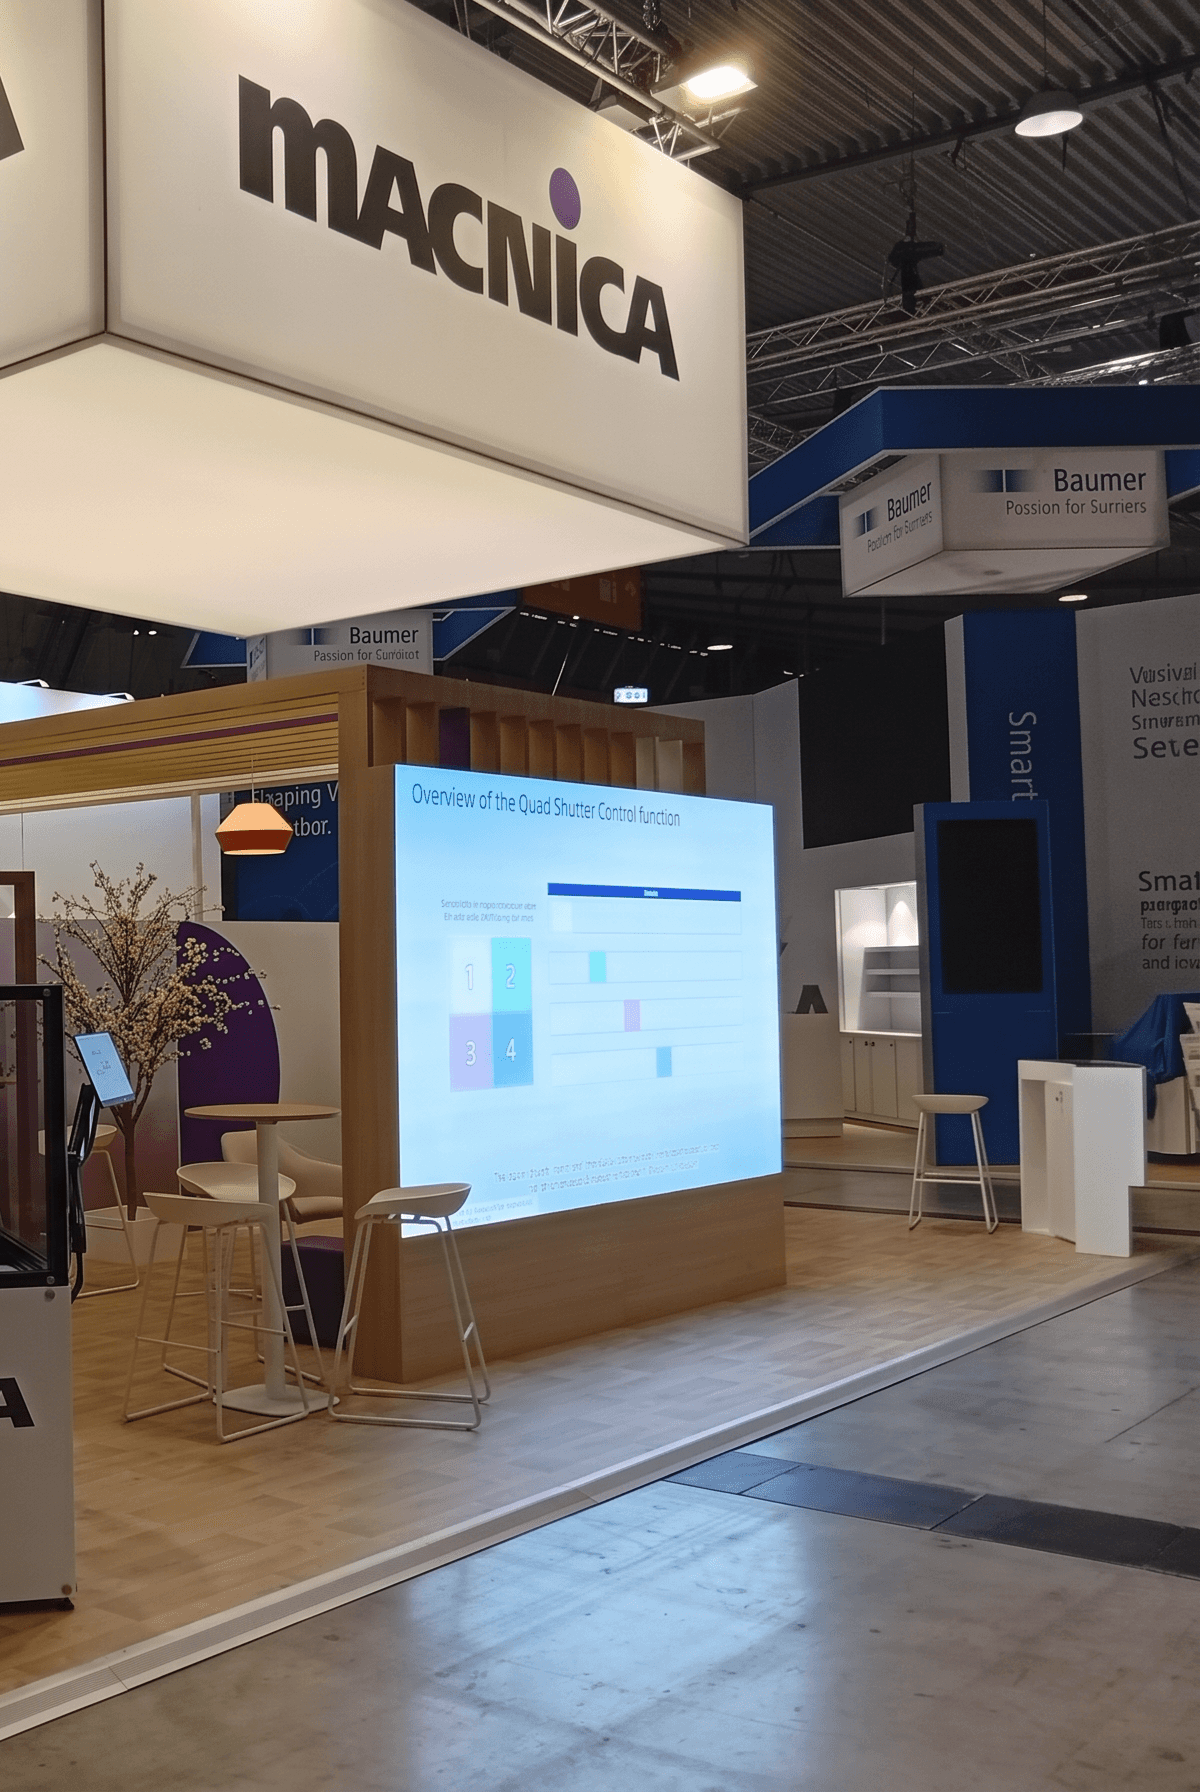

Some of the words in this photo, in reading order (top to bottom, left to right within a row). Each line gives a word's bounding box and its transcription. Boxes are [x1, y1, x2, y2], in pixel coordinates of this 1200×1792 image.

[1054, 468, 1146, 492] Baumer
[887, 482, 932, 521] Baumer
[1065, 498, 1086, 514] for
[350, 627, 419, 644] Baumer
[314, 649, 353, 661] Passion
[357, 649, 372, 660] for
[1008, 711, 1039, 802] Smart
[412, 783, 476, 808] Overview
[479, 790, 493, 810] of
[495, 791, 516, 812] the
[519, 793, 551, 816] Quad
[554, 797, 596, 819] Shutter
[598, 802, 637, 823] Control
[639, 805, 681, 827] function
[1142, 933, 1166, 950] for
[1142, 955, 1170, 970] and
[465, 963, 474, 991] 1
[505, 963, 517, 990] 2
[465, 1039, 477, 1067] 3
[505, 1037, 517, 1063] 4
